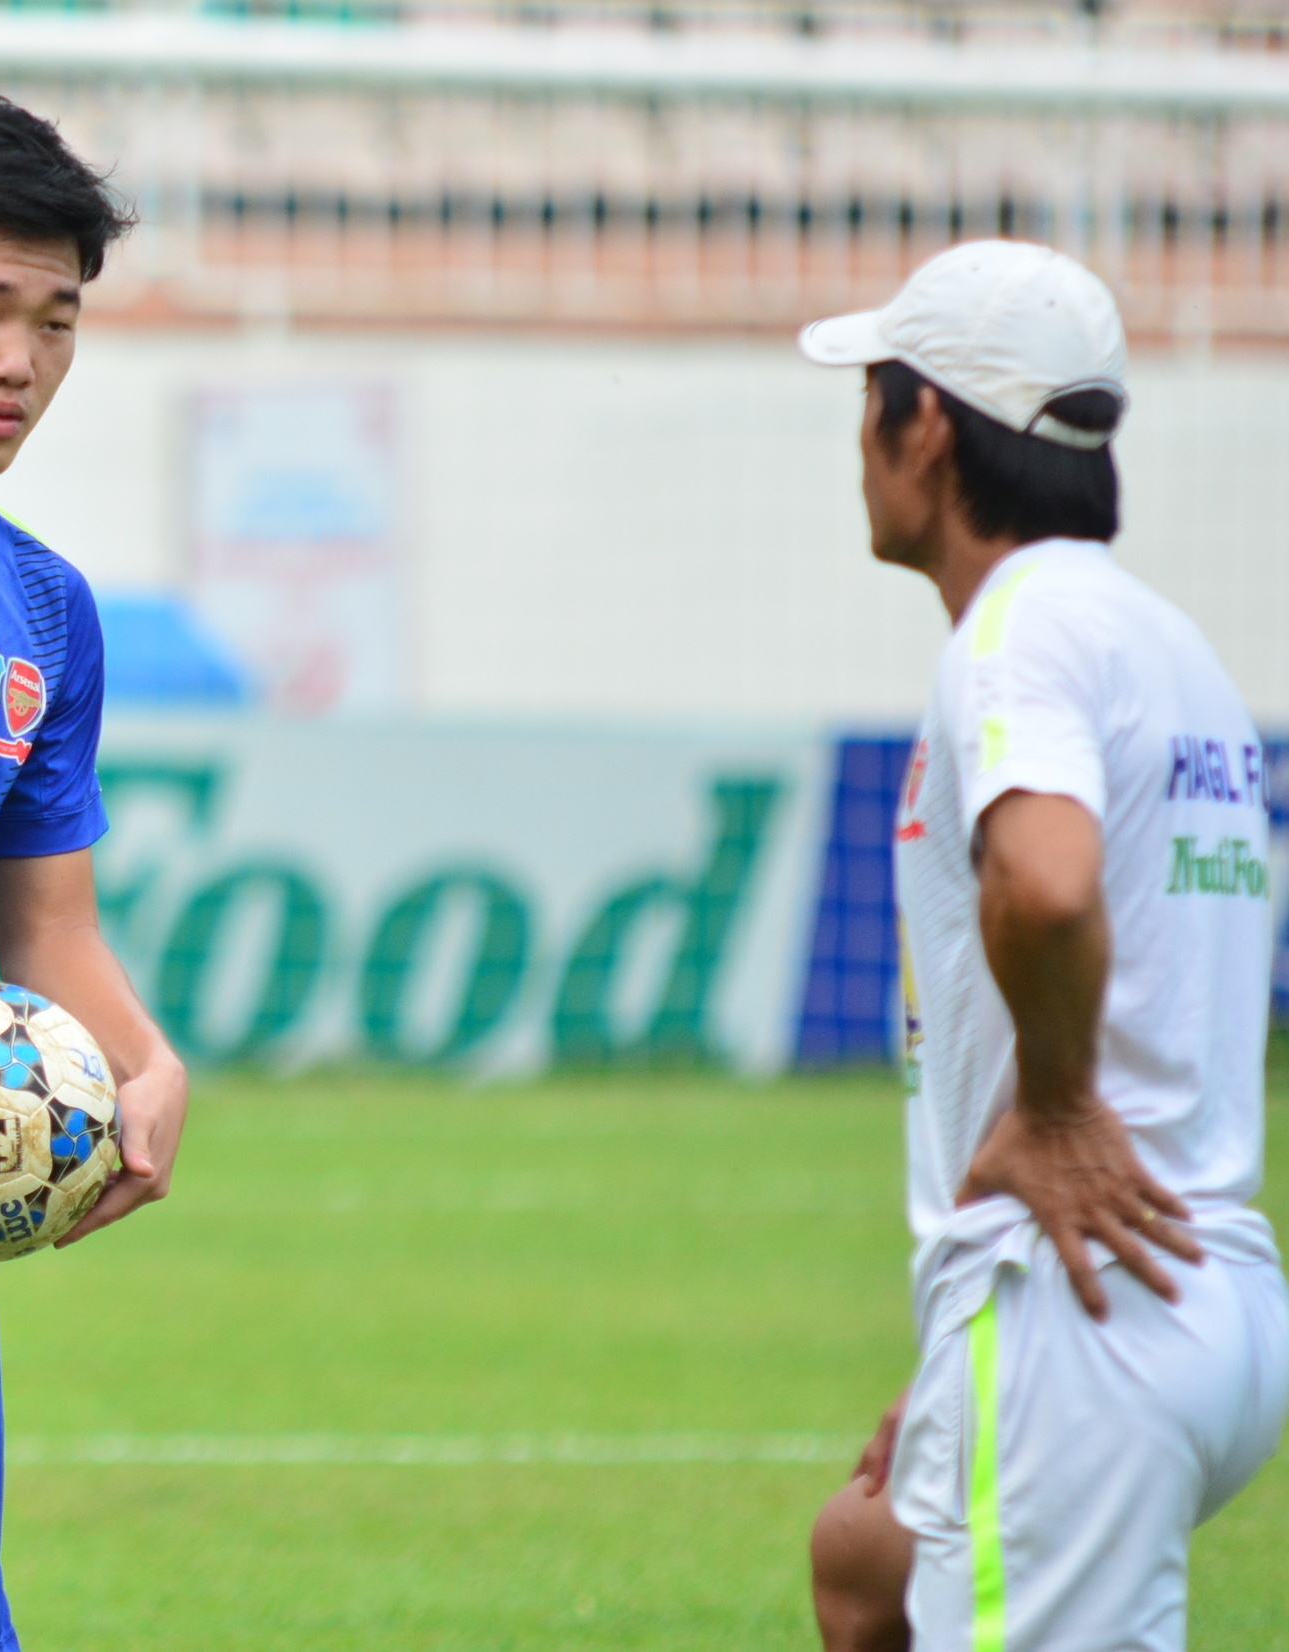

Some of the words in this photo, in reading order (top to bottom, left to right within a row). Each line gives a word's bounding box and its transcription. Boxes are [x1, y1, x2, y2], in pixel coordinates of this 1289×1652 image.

[11, 669, 40, 694] Arsenal
[1167, 735, 1242, 804] HAGL
[1243, 743, 1269, 813] F
[1166, 835, 1270, 900] NutiFo
